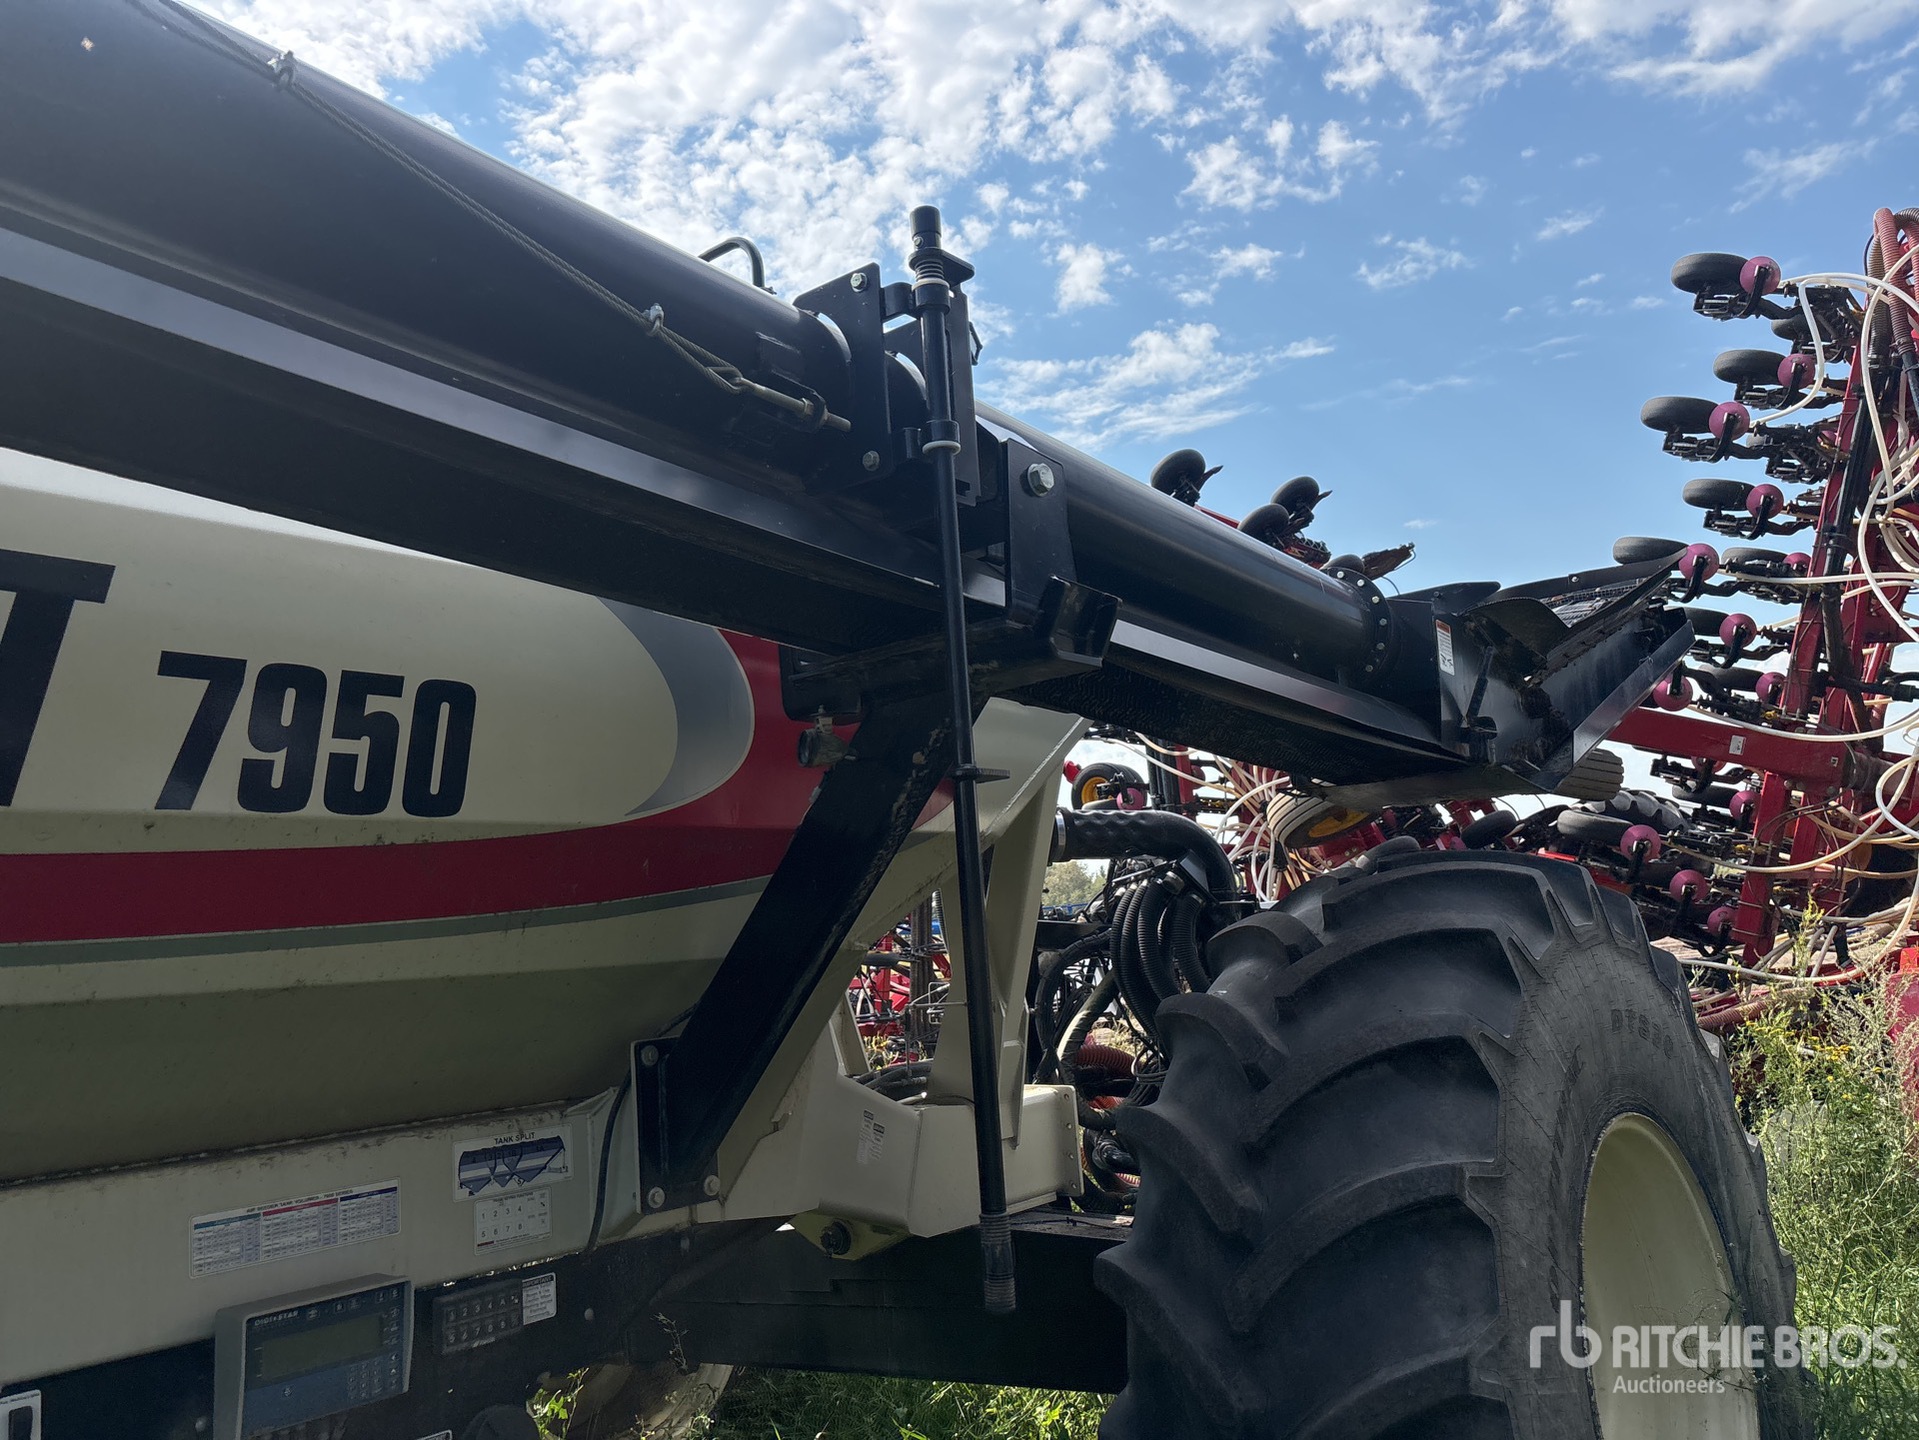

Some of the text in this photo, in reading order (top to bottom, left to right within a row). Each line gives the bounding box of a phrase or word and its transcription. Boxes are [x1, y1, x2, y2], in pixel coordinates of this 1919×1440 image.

[155, 651, 477, 817] 7950
[494, 1132, 536, 1145] TANK SPLIT
[481, 1230, 486, 1238] 5
[493, 1227, 498, 1235] 6
[462, 1307, 468, 1317] 2
[475, 1304, 481, 1313] 3
